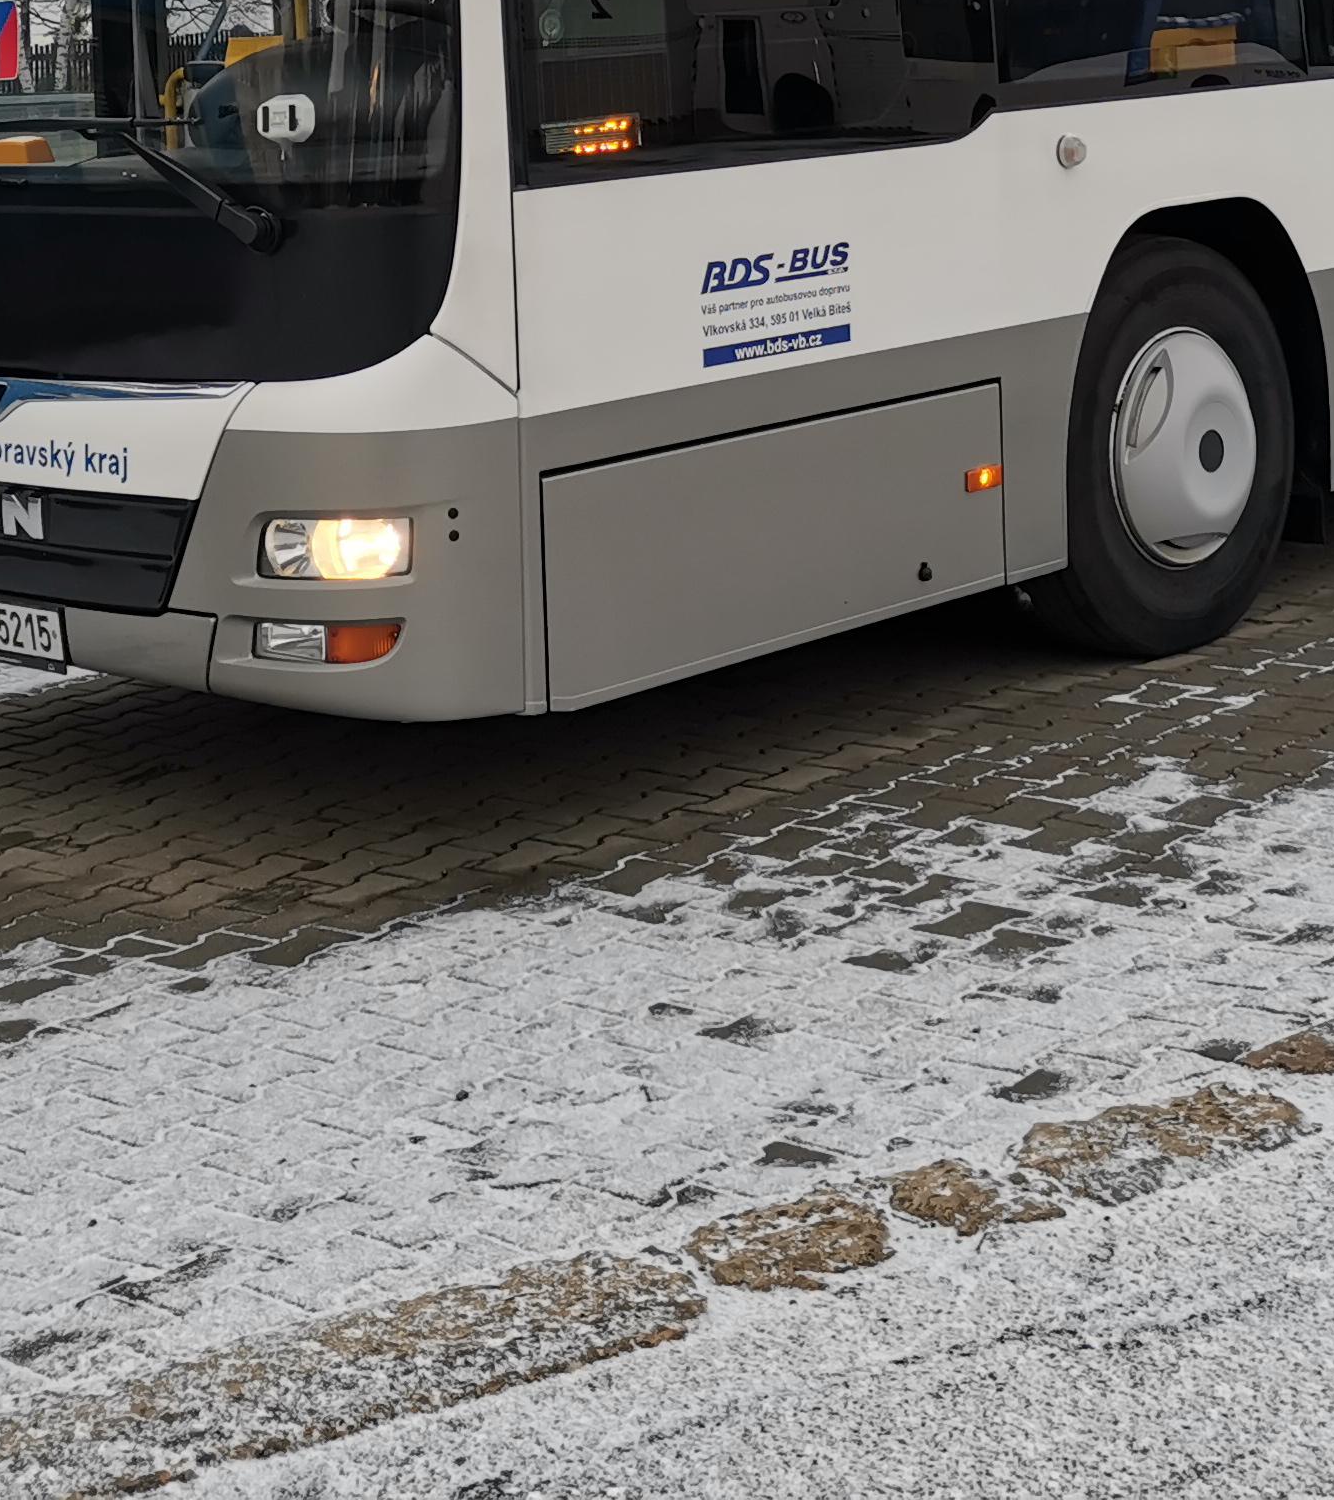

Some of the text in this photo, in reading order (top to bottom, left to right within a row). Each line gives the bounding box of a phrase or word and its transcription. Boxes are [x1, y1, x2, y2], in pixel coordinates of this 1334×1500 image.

[718, 300, 748, 315] partner
[750, 298, 765, 310] pro
[770, 313, 787, 326] 595
[789, 310, 800, 322] 01
[734, 333, 823, 360] www.bds-vb.cz
[84, 444, 128, 483] kraj
